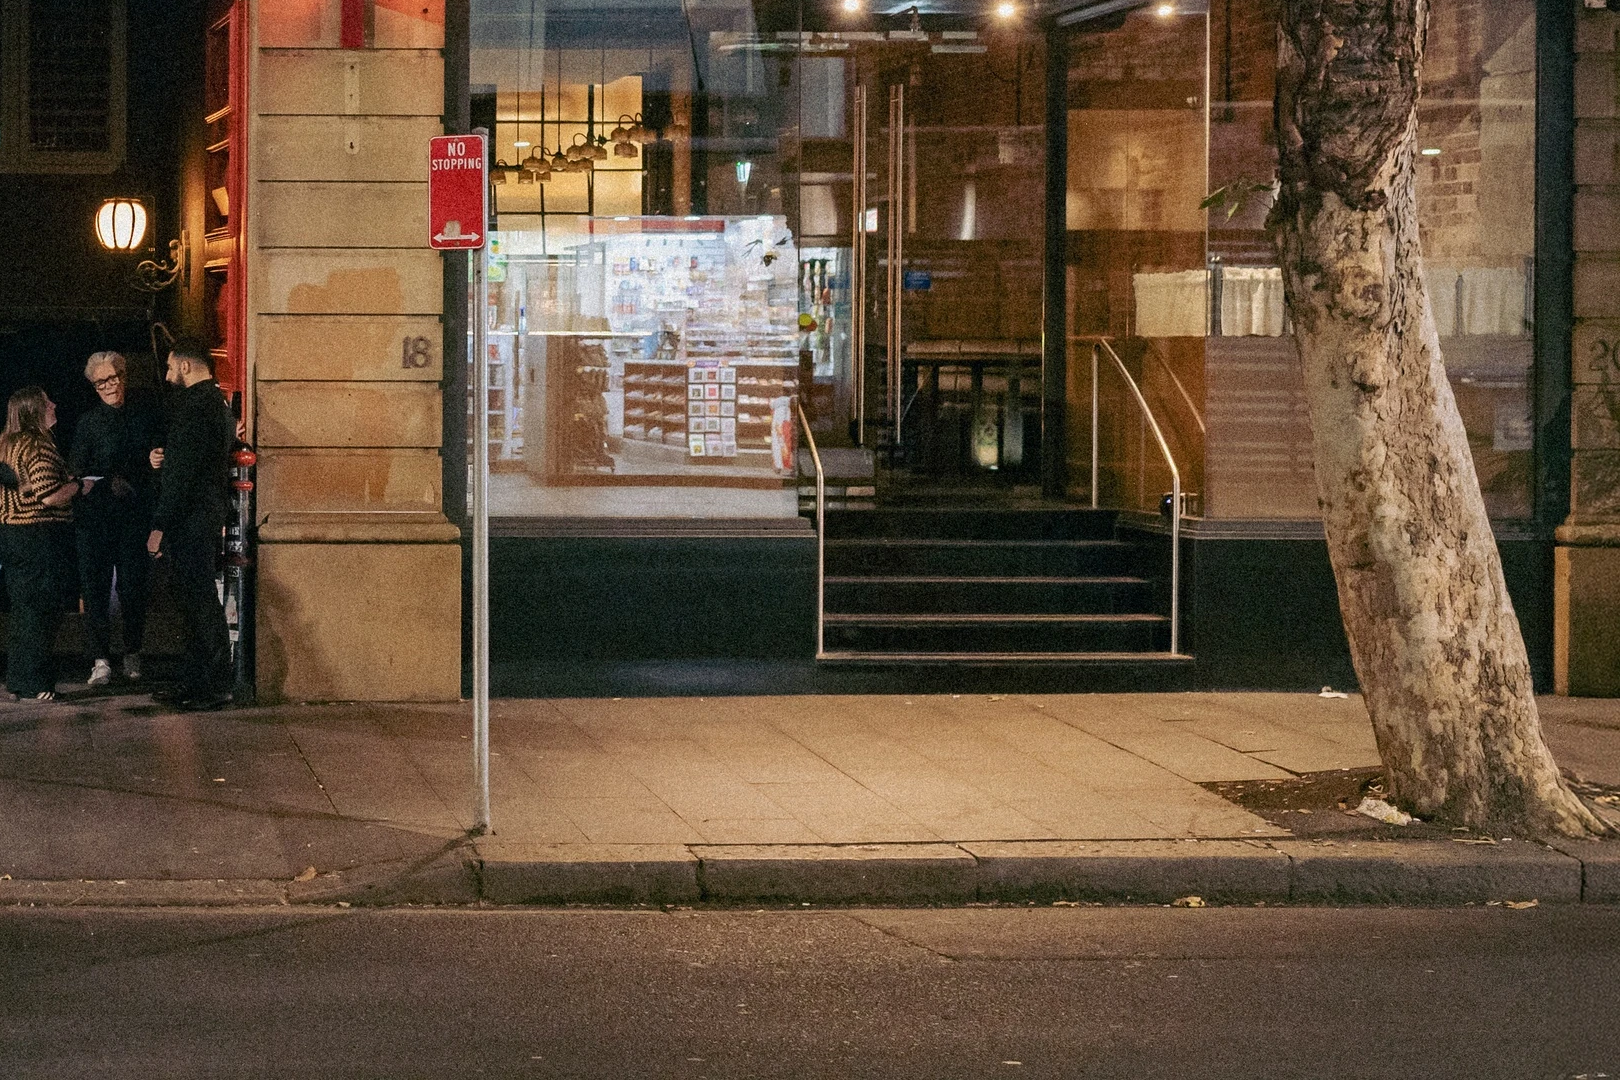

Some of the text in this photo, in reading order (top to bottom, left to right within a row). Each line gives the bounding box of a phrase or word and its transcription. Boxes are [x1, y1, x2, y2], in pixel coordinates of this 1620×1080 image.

[447, 141, 466, 157] NO
[431, 157, 482, 171] STOPPING
[402, 336, 432, 369] 18
